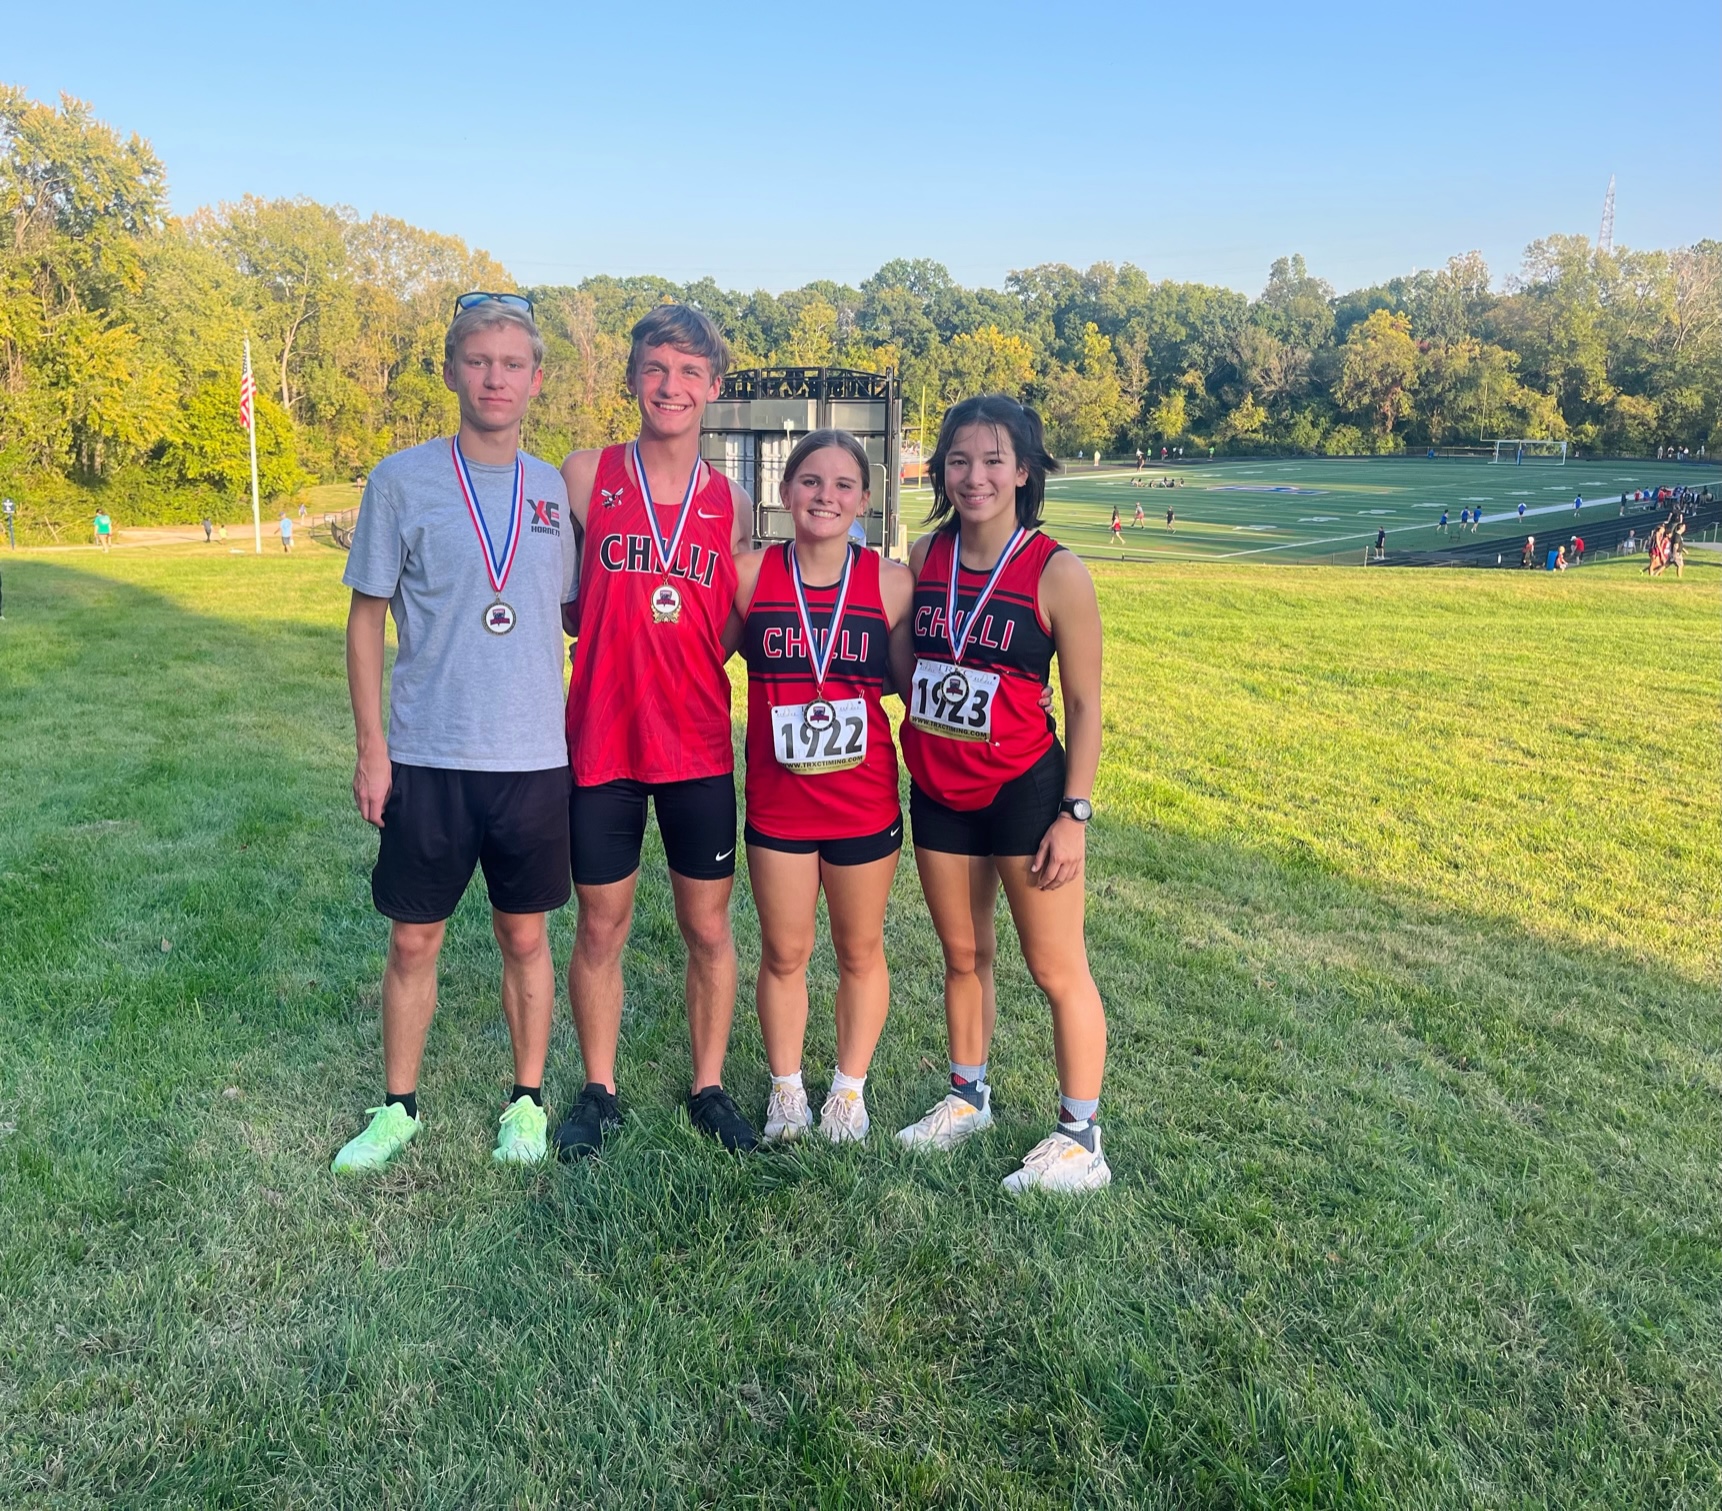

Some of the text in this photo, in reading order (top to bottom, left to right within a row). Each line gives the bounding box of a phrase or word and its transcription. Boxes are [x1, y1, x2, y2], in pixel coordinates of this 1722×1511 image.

[531, 526, 560, 538] HORNETS
[918, 678, 989, 727] 1923
[782, 716, 864, 759] 1922
[912, 716, 988, 738] WWW.TRXCTIMING.COM
